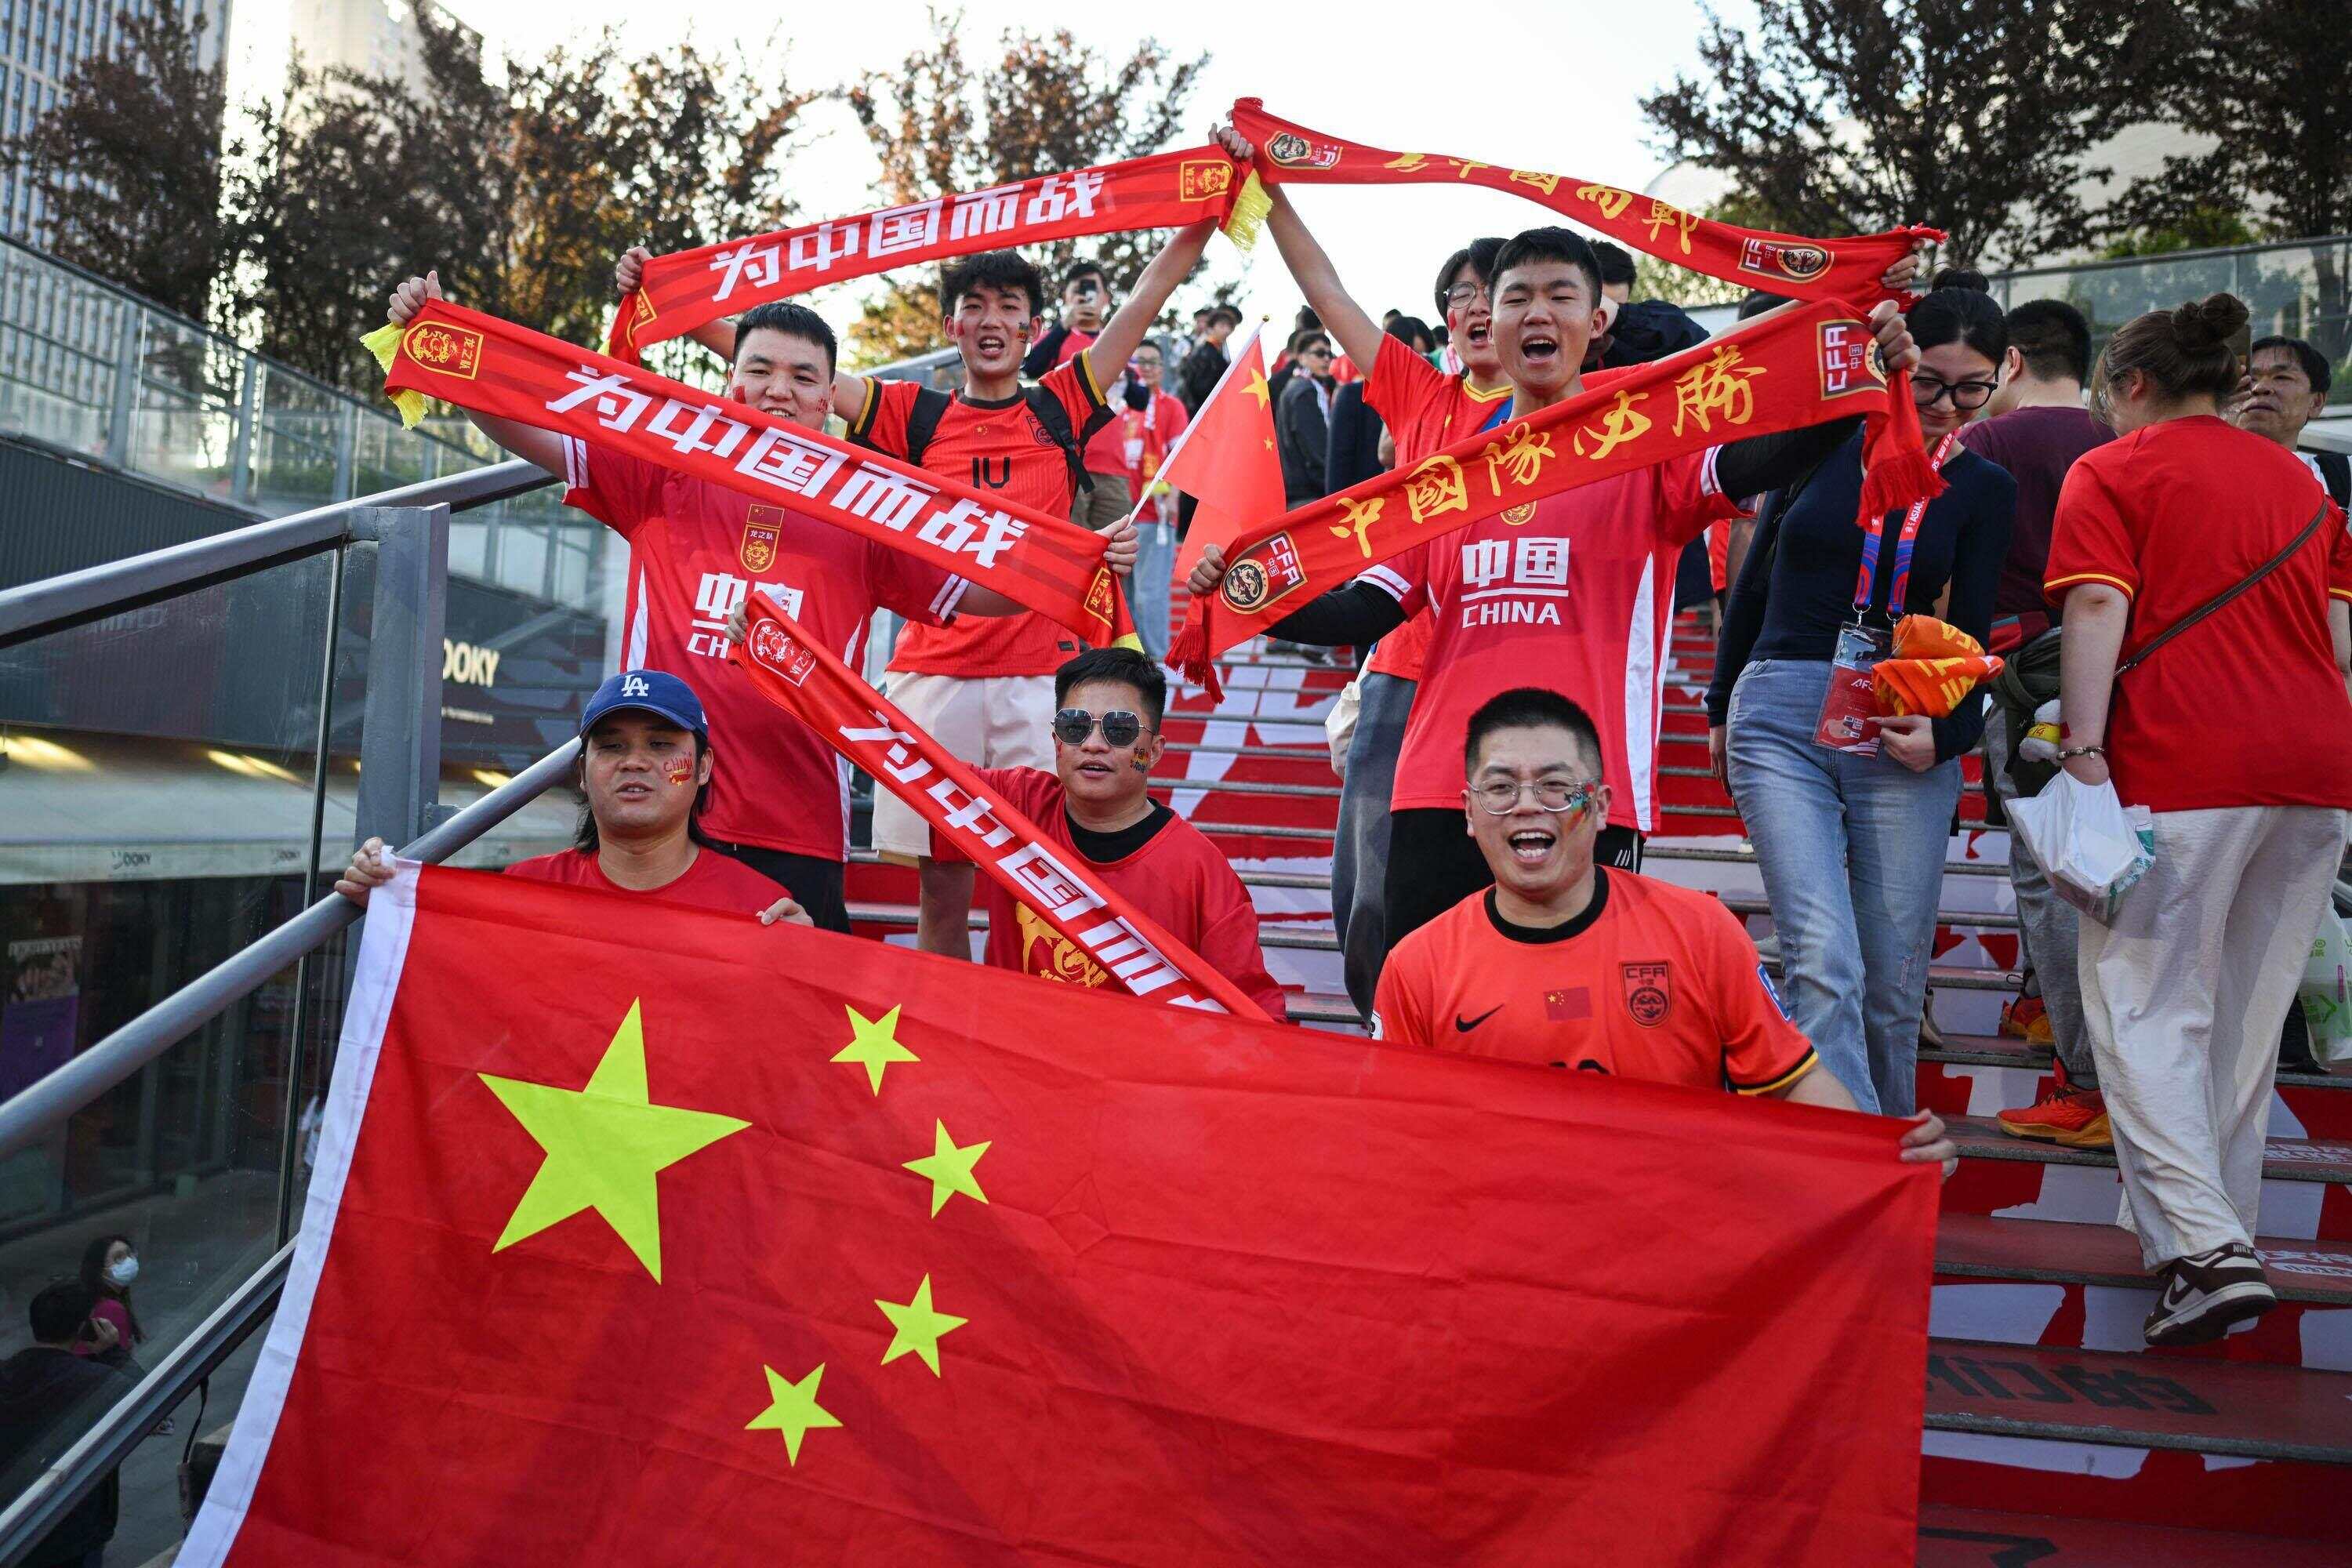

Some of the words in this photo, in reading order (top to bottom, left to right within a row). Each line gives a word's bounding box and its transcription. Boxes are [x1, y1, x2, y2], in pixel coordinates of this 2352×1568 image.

[710, 171, 1105, 302] 为中国而战
[459, 336, 476, 369] 龙之队
[1825, 326, 1848, 392] CFA
[1849, 343, 1863, 369] 中国
[546, 365, 1030, 569] 为中国而战
[750, 529, 774, 541] 龙之队
[1266, 557, 1279, 578] 中国
[1269, 536, 1301, 586] CFA
[1461, 537, 1570, 588] 中国
[1090, 578, 1111, 608] 龙之队
[1461, 601, 1562, 629] CHINA
[621, 674, 649, 697] LA
[1625, 967, 1666, 978] CFA
